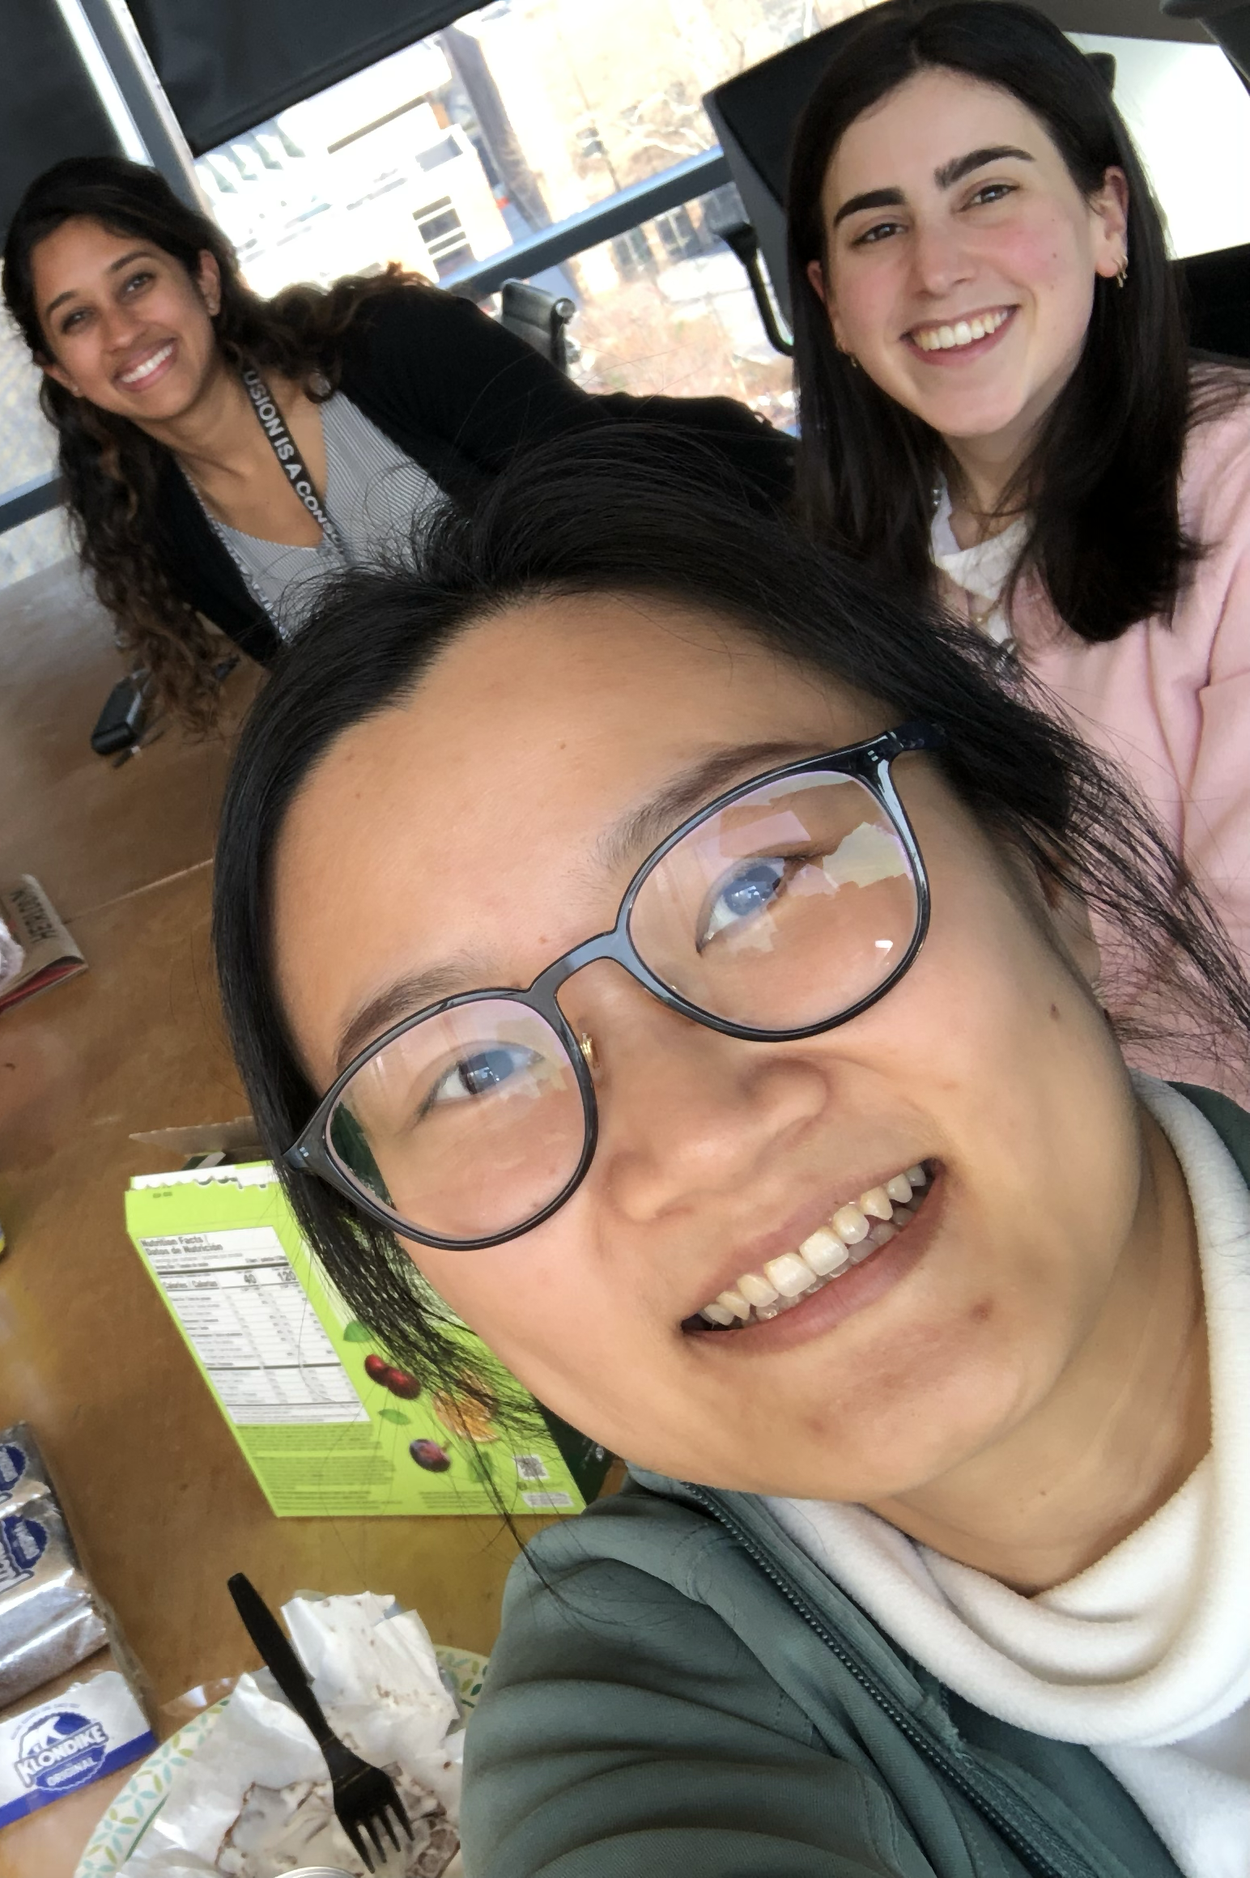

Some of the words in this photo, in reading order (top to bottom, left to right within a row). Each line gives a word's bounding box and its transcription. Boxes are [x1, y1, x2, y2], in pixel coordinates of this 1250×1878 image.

[273, 437, 295, 461] IS
[285, 463, 302, 480] A
[277, 1270, 297, 1282] 120
[16, 1724, 107, 1786] KLONDIKE
